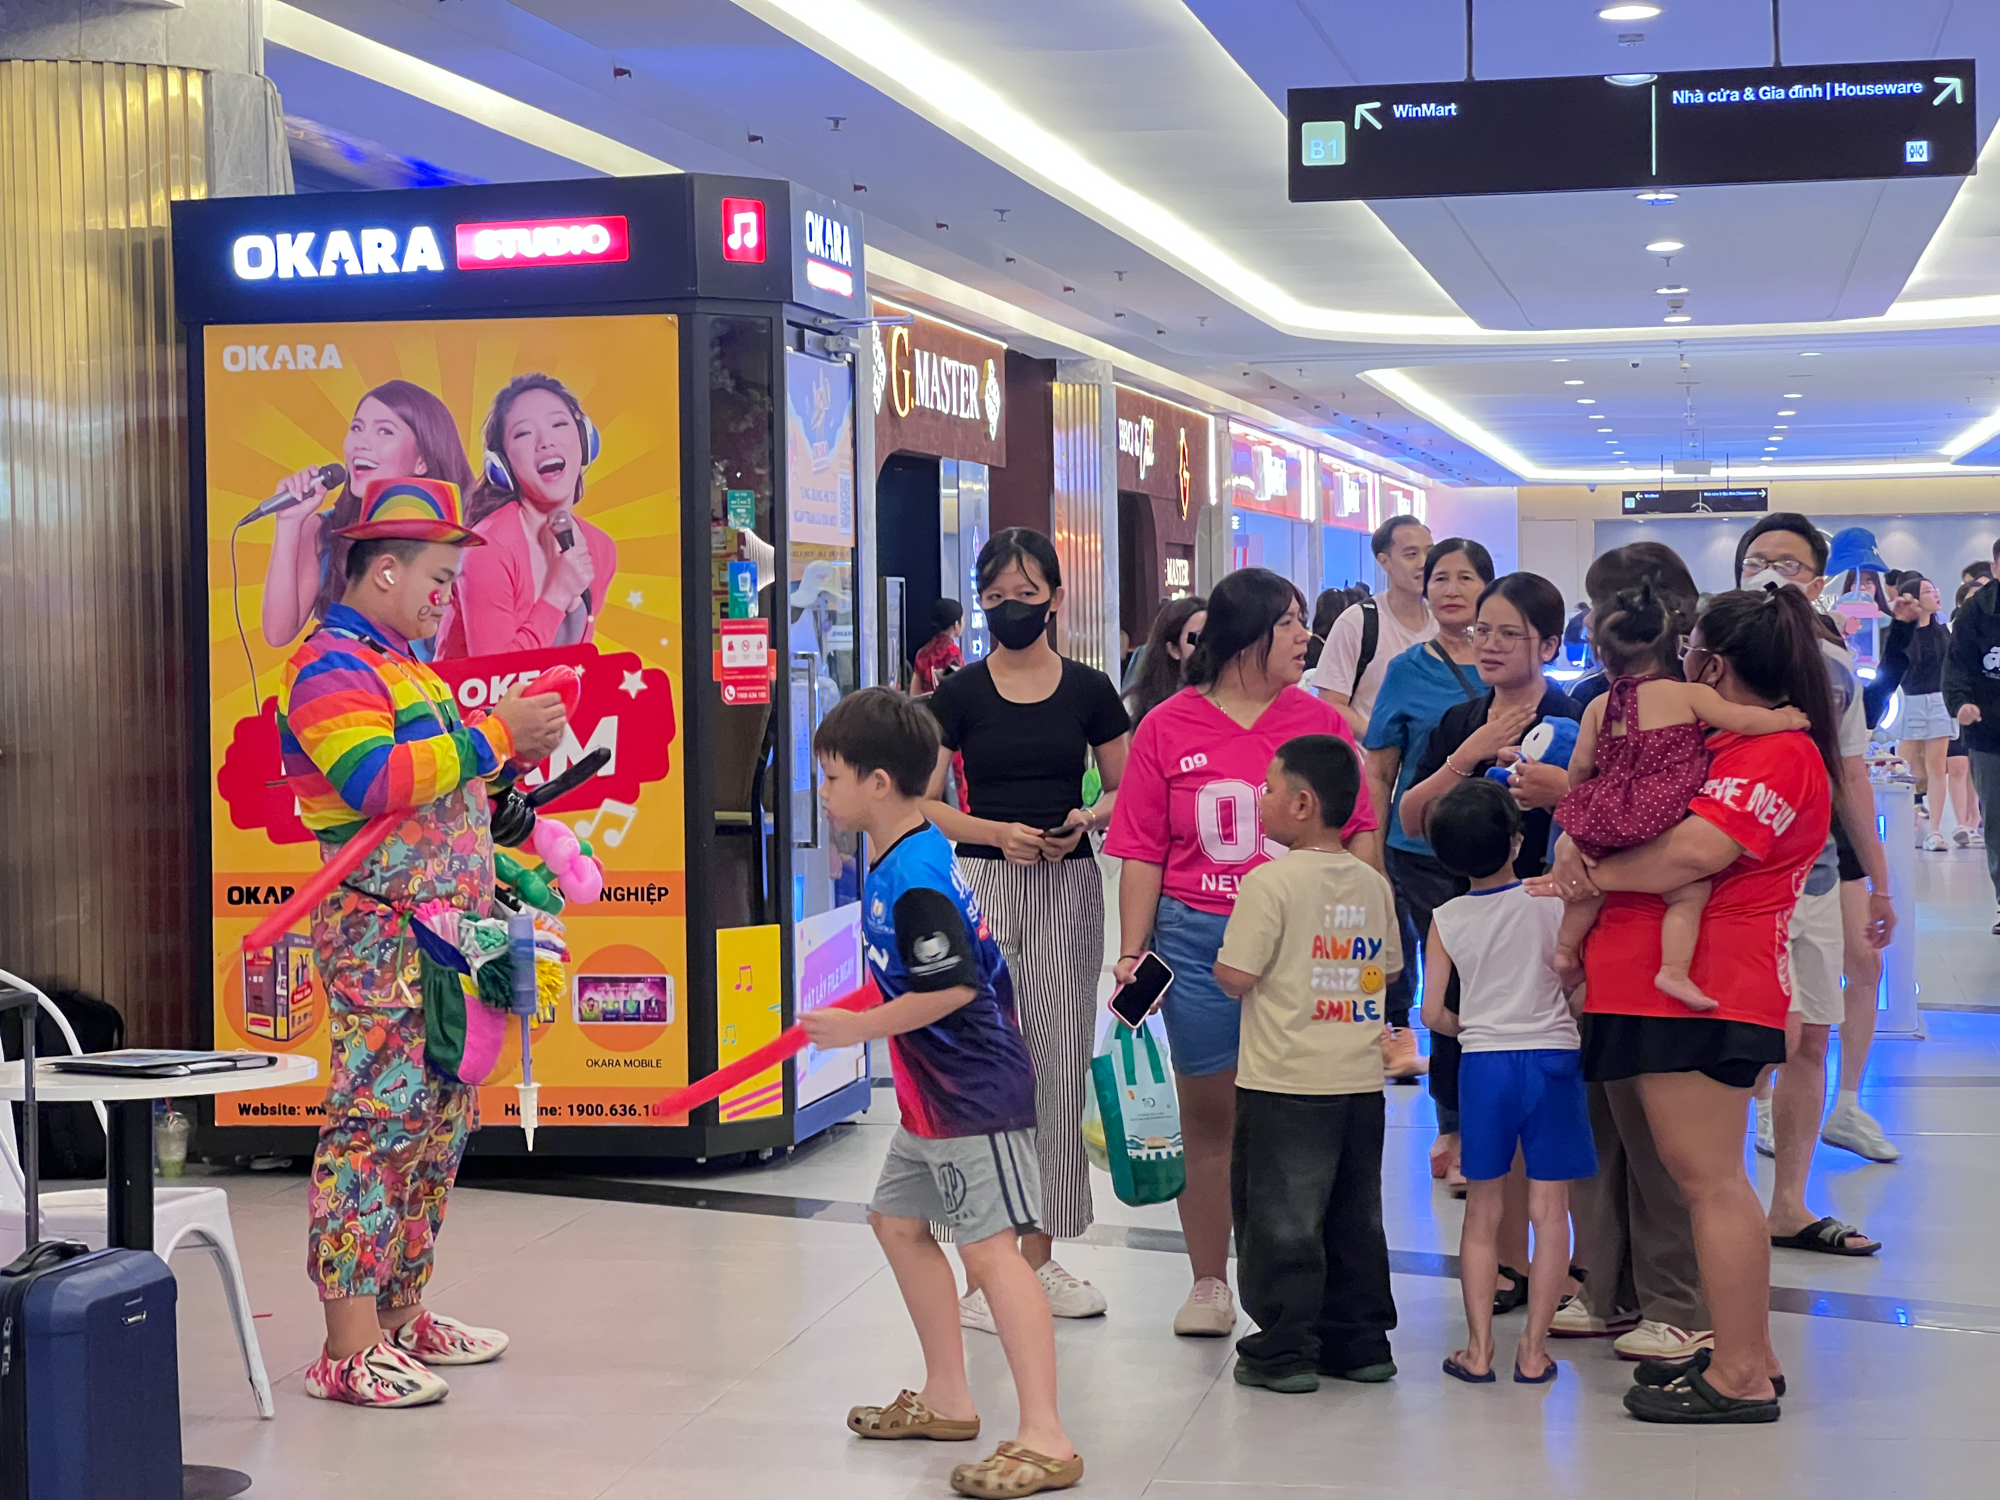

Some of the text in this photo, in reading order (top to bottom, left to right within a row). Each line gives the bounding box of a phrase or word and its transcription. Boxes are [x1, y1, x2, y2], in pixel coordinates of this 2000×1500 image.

[1672, 89, 1704, 104] Nhà
[1707, 87, 1740, 103] cửa
[1743, 86, 1756, 102] &
[1758, 85, 1785, 100] Gia
[1834, 82, 1923, 97] Houseware
[1393, 102, 1458, 118] WinMart
[1309, 138, 1338, 159] B1
[805, 210, 852, 268] OKARA
[233, 224, 611, 280] OKARA STUDIO
[222, 343, 343, 372] OKARA
[1180, 753, 1208, 772] 09
[1746, 782, 1797, 837] NEW
[1334, 904, 1366, 929] AM
[1311, 999, 1381, 1022] SMILE
[586, 1058, 662, 1068] OKARA MOBILE
[238, 1102, 301, 1116] Website:
[567, 1103, 662, 1117] 1900.636.10
